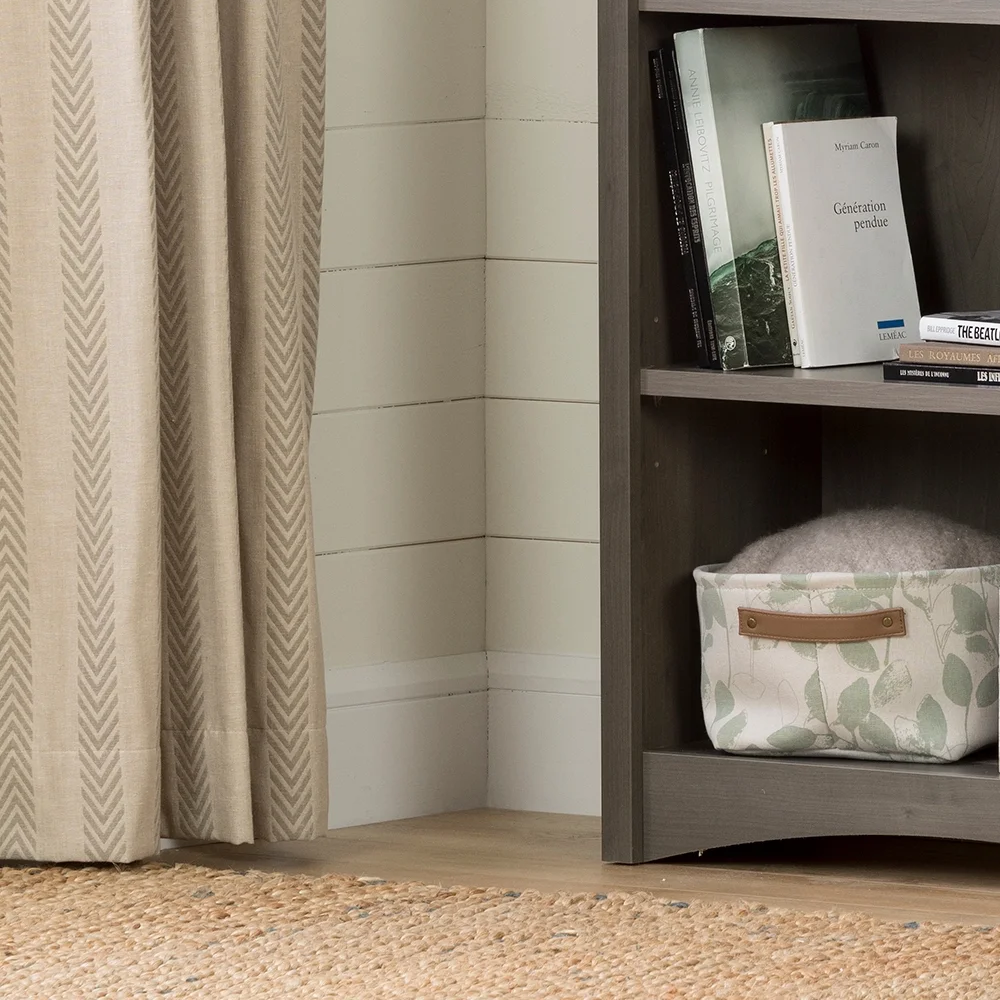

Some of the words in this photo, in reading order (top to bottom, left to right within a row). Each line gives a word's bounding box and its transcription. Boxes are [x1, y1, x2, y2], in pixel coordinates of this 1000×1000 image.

[688, 68, 701, 108] ANNIE
[694, 112, 711, 173] LEIBOVITZ
[834, 142, 859, 153] Myriam
[860, 141, 880, 150] Caron
[768, 138, 776, 174] ALLUMETTES
[833, 200, 887, 216] Génération
[704, 181, 723, 253] PILGRIMAGE
[854, 215, 889, 233] pendue
[878, 330, 908, 341] LEMÉAC
[957, 324, 974, 339] THE
[909, 350, 924, 360] LES
[929, 350, 981, 363] ROYAUMES
[977, 371, 989, 382] LES
